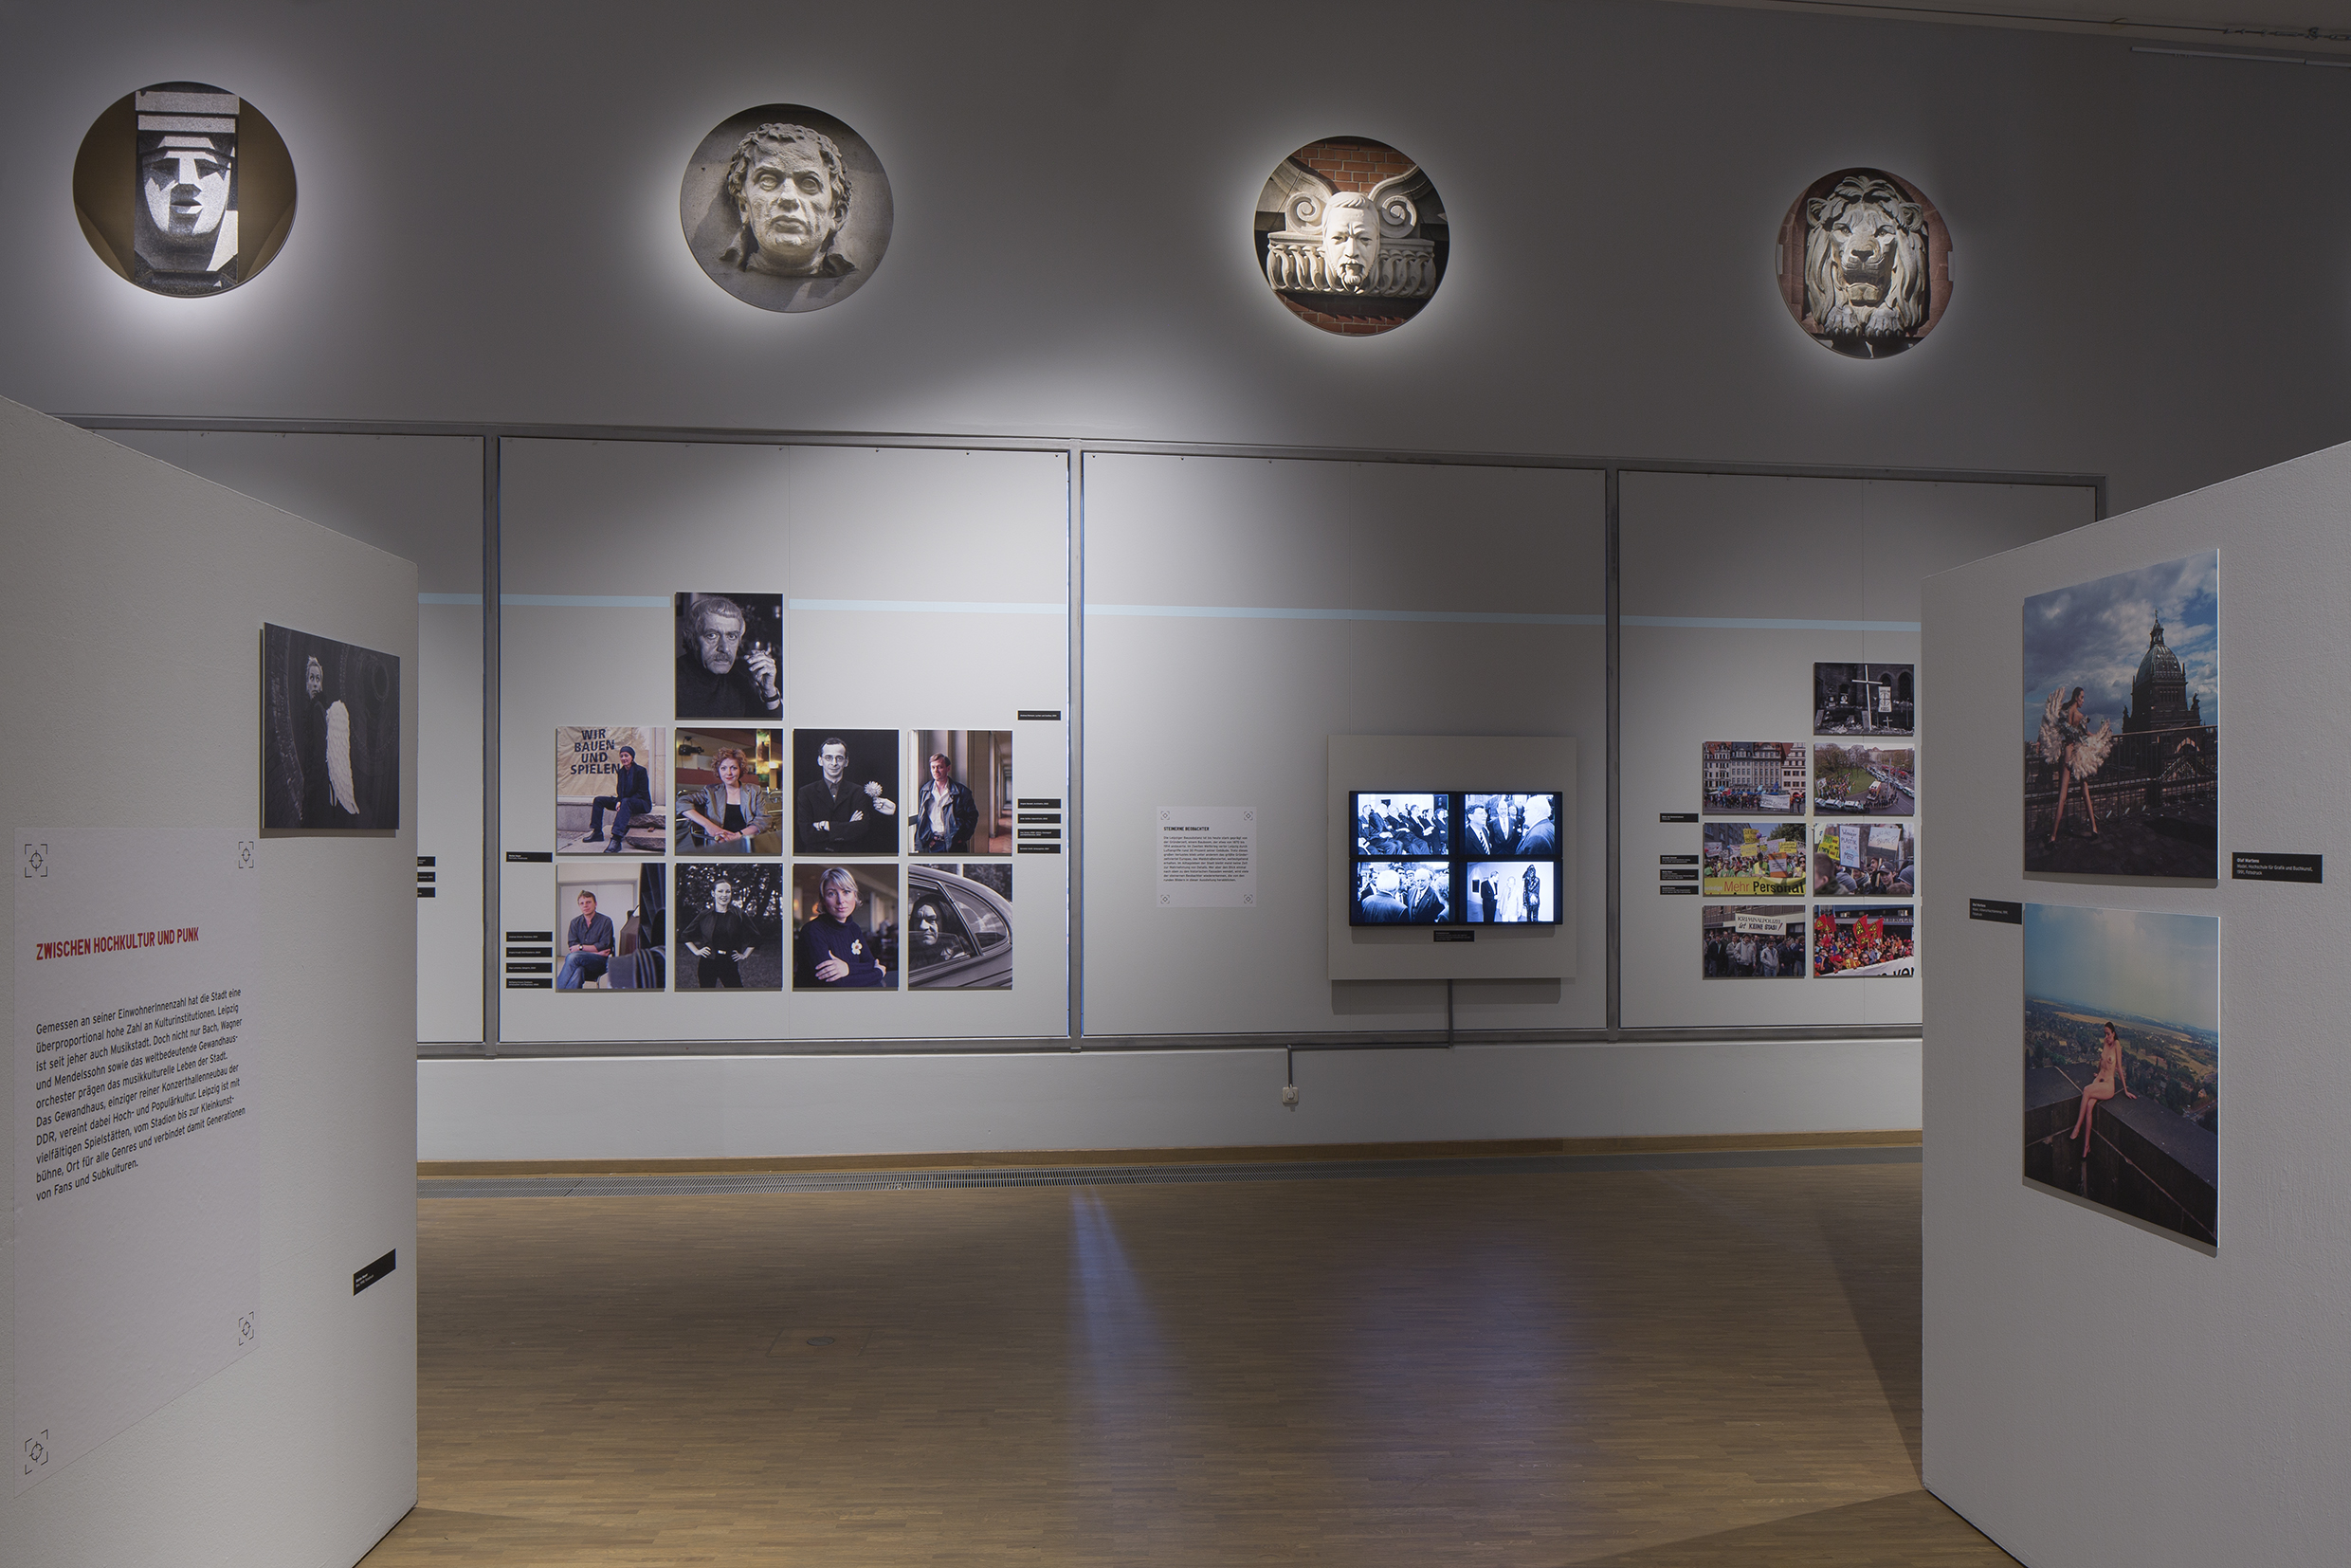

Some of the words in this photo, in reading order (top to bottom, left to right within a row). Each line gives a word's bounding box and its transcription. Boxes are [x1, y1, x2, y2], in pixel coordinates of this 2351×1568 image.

[574, 739, 614, 752] BAUEN
[581, 728, 607, 740] WIR
[581, 752, 608, 763] UND
[571, 763, 620, 775] SPIELEN
[1724, 882, 1750, 892] Mehr
[1753, 882, 1804, 893] Personal
[36, 939, 91, 960] ZWISCHEN
[93, 932, 155, 954] HOCHKULTUR
[157, 930, 174, 946] UND
[176, 927, 199, 943] PUNK
[36, 1019, 78, 1034] Gemessen
[80, 1016, 90, 1026] an
[92, 1012, 116, 1024] seiner
[118, 996, 186, 1019] EinwohnerInnenzahl
[188, 994, 198, 1006] hat
[199, 993, 210, 1003] die
[210, 990, 227, 1001] Stadt
[228, 988, 241, 997] eine
[36, 1030, 103, 1053] überproportional
[106, 1027, 124, 1038] hohe
[126, 1022, 142, 1034] Zahl
[143, 1022, 153, 1030] an
[155, 1009, 216, 1029] Kulturinstitutionen.
[217, 1003, 238, 1015] Leipzig
[36, 1059, 46, 1071] ist
[49, 1055, 64, 1068] seit
[66, 1052, 87, 1067] jeher
[89, 1046, 108, 1060] auch
[110, 1037, 151, 1055] Musikstadt.
[153, 1032, 170, 1045] Doch
[172, 1029, 188, 1041] nicht
[190, 1028, 201, 1037] nur
[202, 1022, 219, 1034] Bach,
[220, 1018, 242, 1030] Wagner
[36, 1076, 51, 1090] und
[54, 1066, 105, 1085] Mendelssohn
[107, 1059, 128, 1073] sowie
[130, 1056, 143, 1067] das
[144, 1043, 197, 1064] weltbedeutende
[198, 1034, 238, 1050] Gewandhaus-
[36, 1090, 76, 1109] orchester
[78, 1084, 105, 1100] prägen
[106, 1079, 120, 1090] das
[122, 1065, 174, 1086] musikkulturelle
[176, 1060, 196, 1072] Leben
[197, 1056, 209, 1067] der
[210, 1050, 228, 1064] Stadt.
[36, 1115, 52, 1127] Das
[54, 1101, 106, 1121] Gewandhaus,
[108, 1091, 137, 1107] einziger
[138, 1085, 160, 1099] reiner
[161, 1067, 228, 1092] Konzerthallenneubau
[228, 1064, 239, 1073] der
[36, 1130, 57, 1146] DDR,
[59, 1121, 87, 1139] vereint
[89, 1114, 110, 1130] dabei
[113, 1109, 134, 1123] Hoch-
[136, 1103, 149, 1116] und
[151, 1091, 196, 1111] Populärkultur.
[197, 1084, 220, 1098] Leipzig
[229, 1077, 240, 1088] mit
[36, 1142, 82, 1164] vielfältigen
[83, 1128, 132, 1150] Spielstätten,
[133, 1122, 149, 1133] vom
[150, 1114, 176, 1128] Stadion
[177, 1109, 187, 1120] bis
[189, 1106, 199, 1117] zur
[201, 1095, 234, 1113] Kleinkunst-
[36, 1167, 64, 1183] bühne,
[65, 1158, 80, 1173] Ort
[82, 1155, 94, 1168] für
[95, 1151, 109, 1163] alle
[111, 1142, 137, 1158] Genres
[138, 1136, 152, 1149] und
[154, 1124, 185, 1143] verbindet
[186, 1119, 205, 1133] damit
[206, 1107, 246, 1126] Generationen
[36, 1189, 51, 1201] von
[54, 1181, 72, 1195] Fans
[75, 1173, 89, 1188] und
[92, 1159, 138, 1181] Subkulturen.
